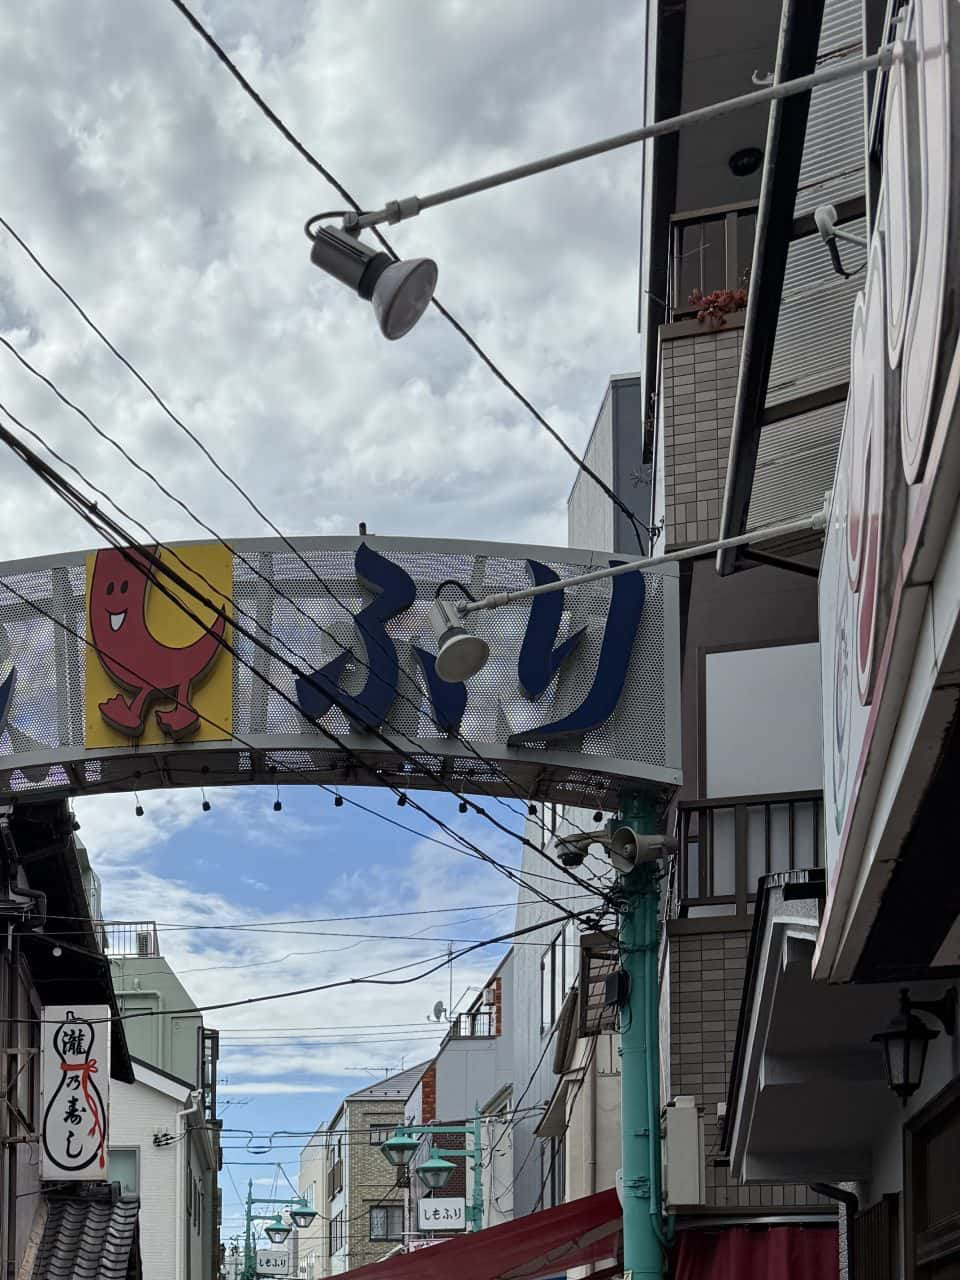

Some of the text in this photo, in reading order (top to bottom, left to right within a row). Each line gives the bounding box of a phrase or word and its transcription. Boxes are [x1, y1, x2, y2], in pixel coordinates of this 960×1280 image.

[61, 1028, 87, 1159] 瀧乃寿し
[423, 1207, 462, 1221] しもふり
[258, 1258, 287, 1269] しもふり
